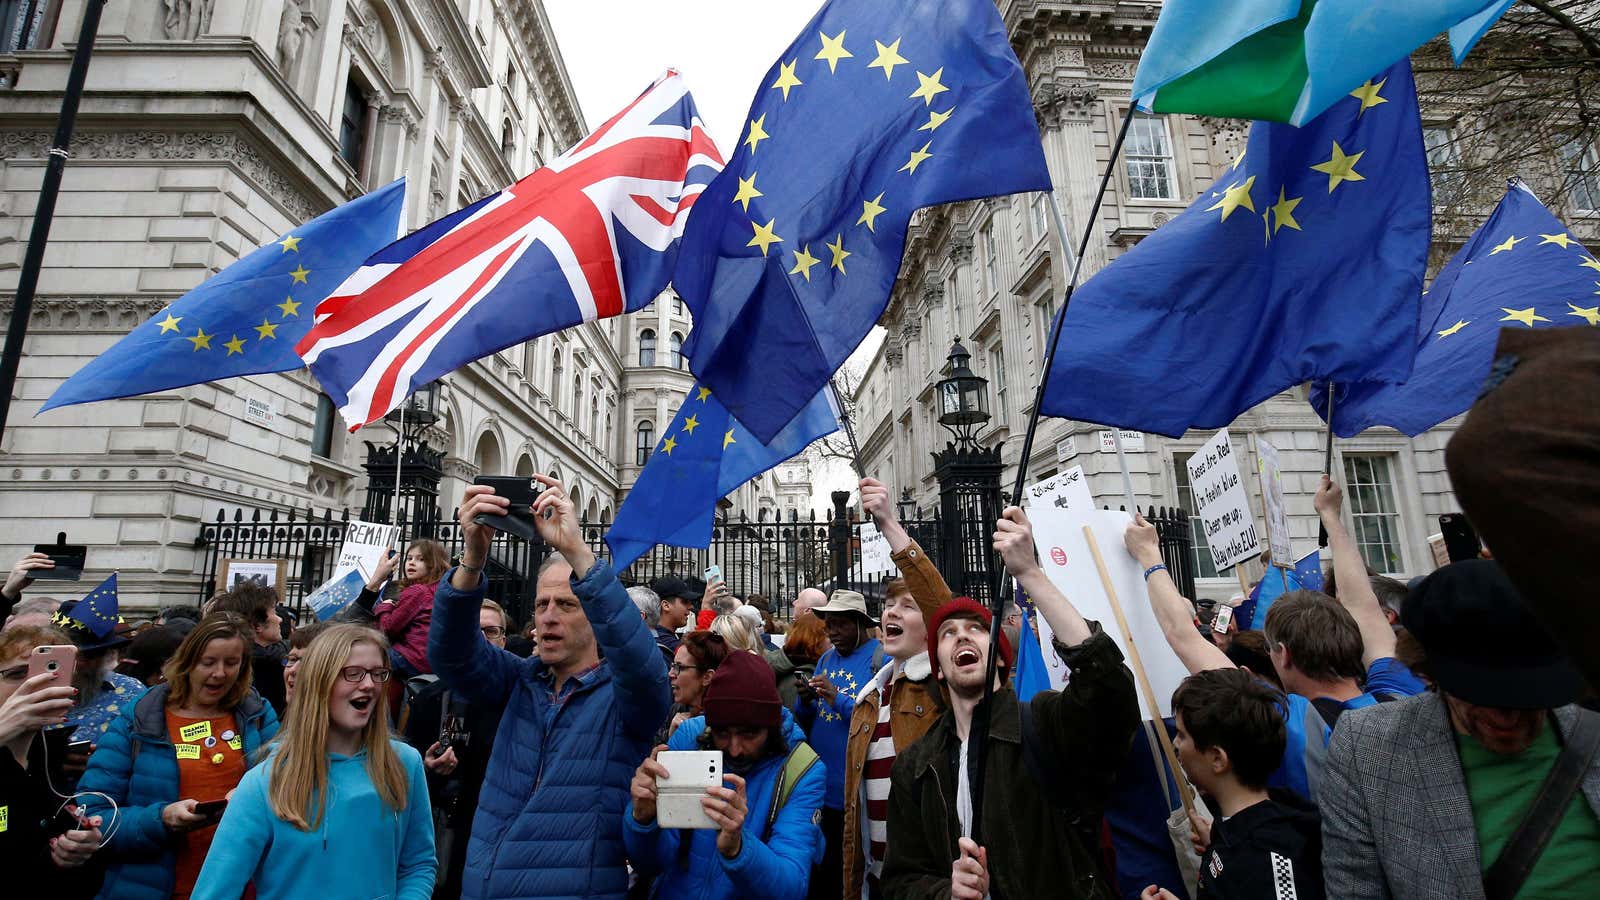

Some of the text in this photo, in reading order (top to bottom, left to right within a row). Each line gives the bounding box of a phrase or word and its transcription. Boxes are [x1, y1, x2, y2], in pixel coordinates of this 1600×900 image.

[248, 406, 265, 417] STREET
[1190, 436, 1230, 480] Roses Are Red
[1221, 472, 1238, 491] blue
[345, 523, 400, 547] REMAIN
[1205, 518, 1221, 536] Cheer
[1222, 512, 1231, 528] me
[1211, 544, 1228, 566] Stay
[1230, 538, 1243, 557] the
[1240, 524, 1258, 552] EU!
